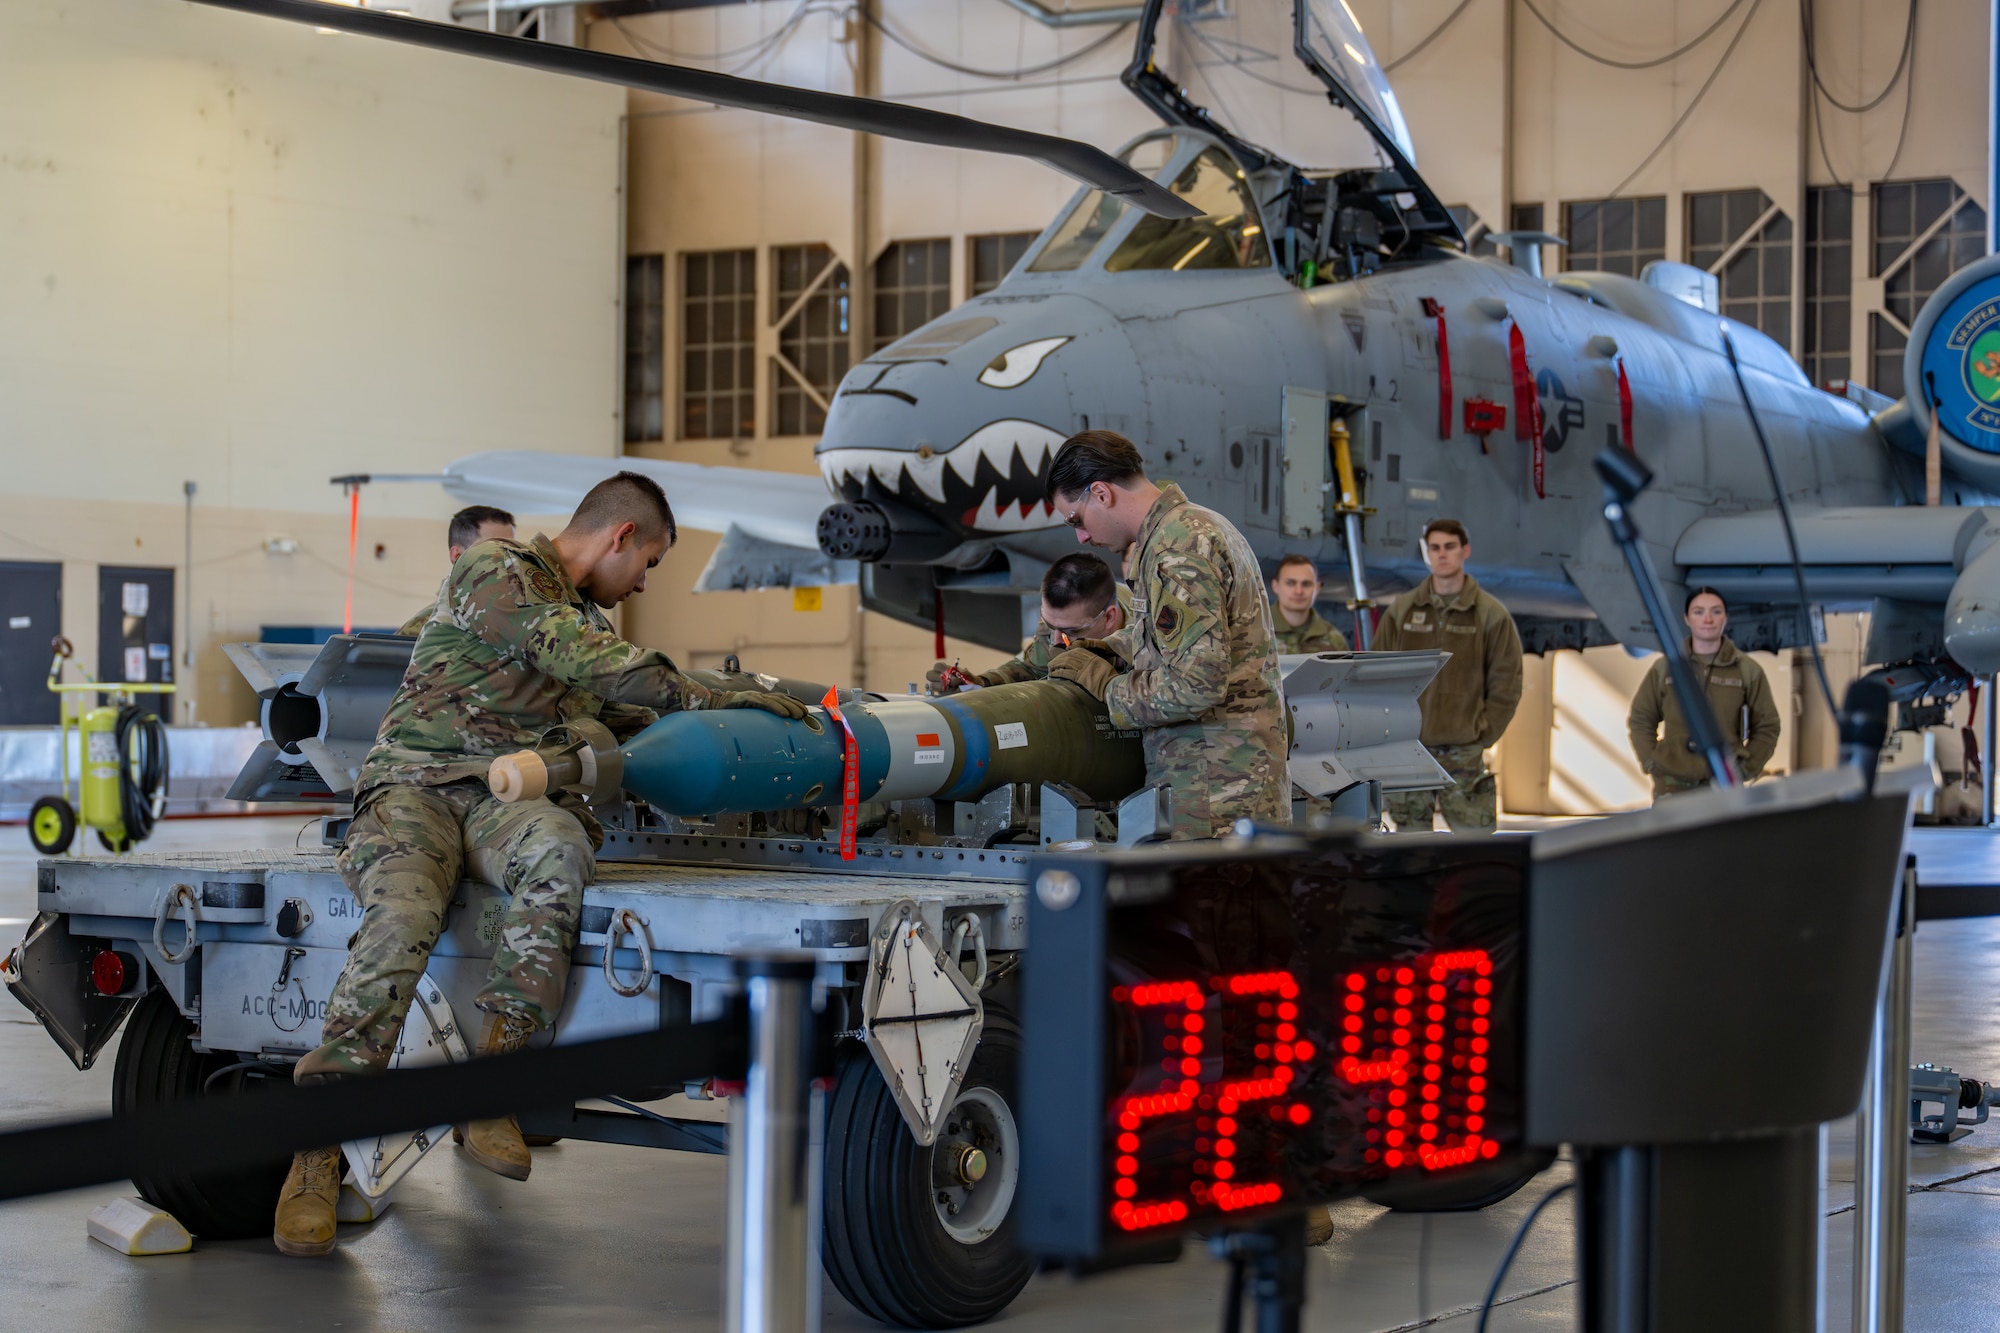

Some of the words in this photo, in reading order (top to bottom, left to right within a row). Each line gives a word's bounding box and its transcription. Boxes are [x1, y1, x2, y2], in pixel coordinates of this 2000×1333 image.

[1955, 304, 1997, 344] SEMPER
[847, 742, 857, 800] BEFORE
[843, 804, 856, 854] FLIGHT
[1114, 949, 1498, 1231] 22:40
